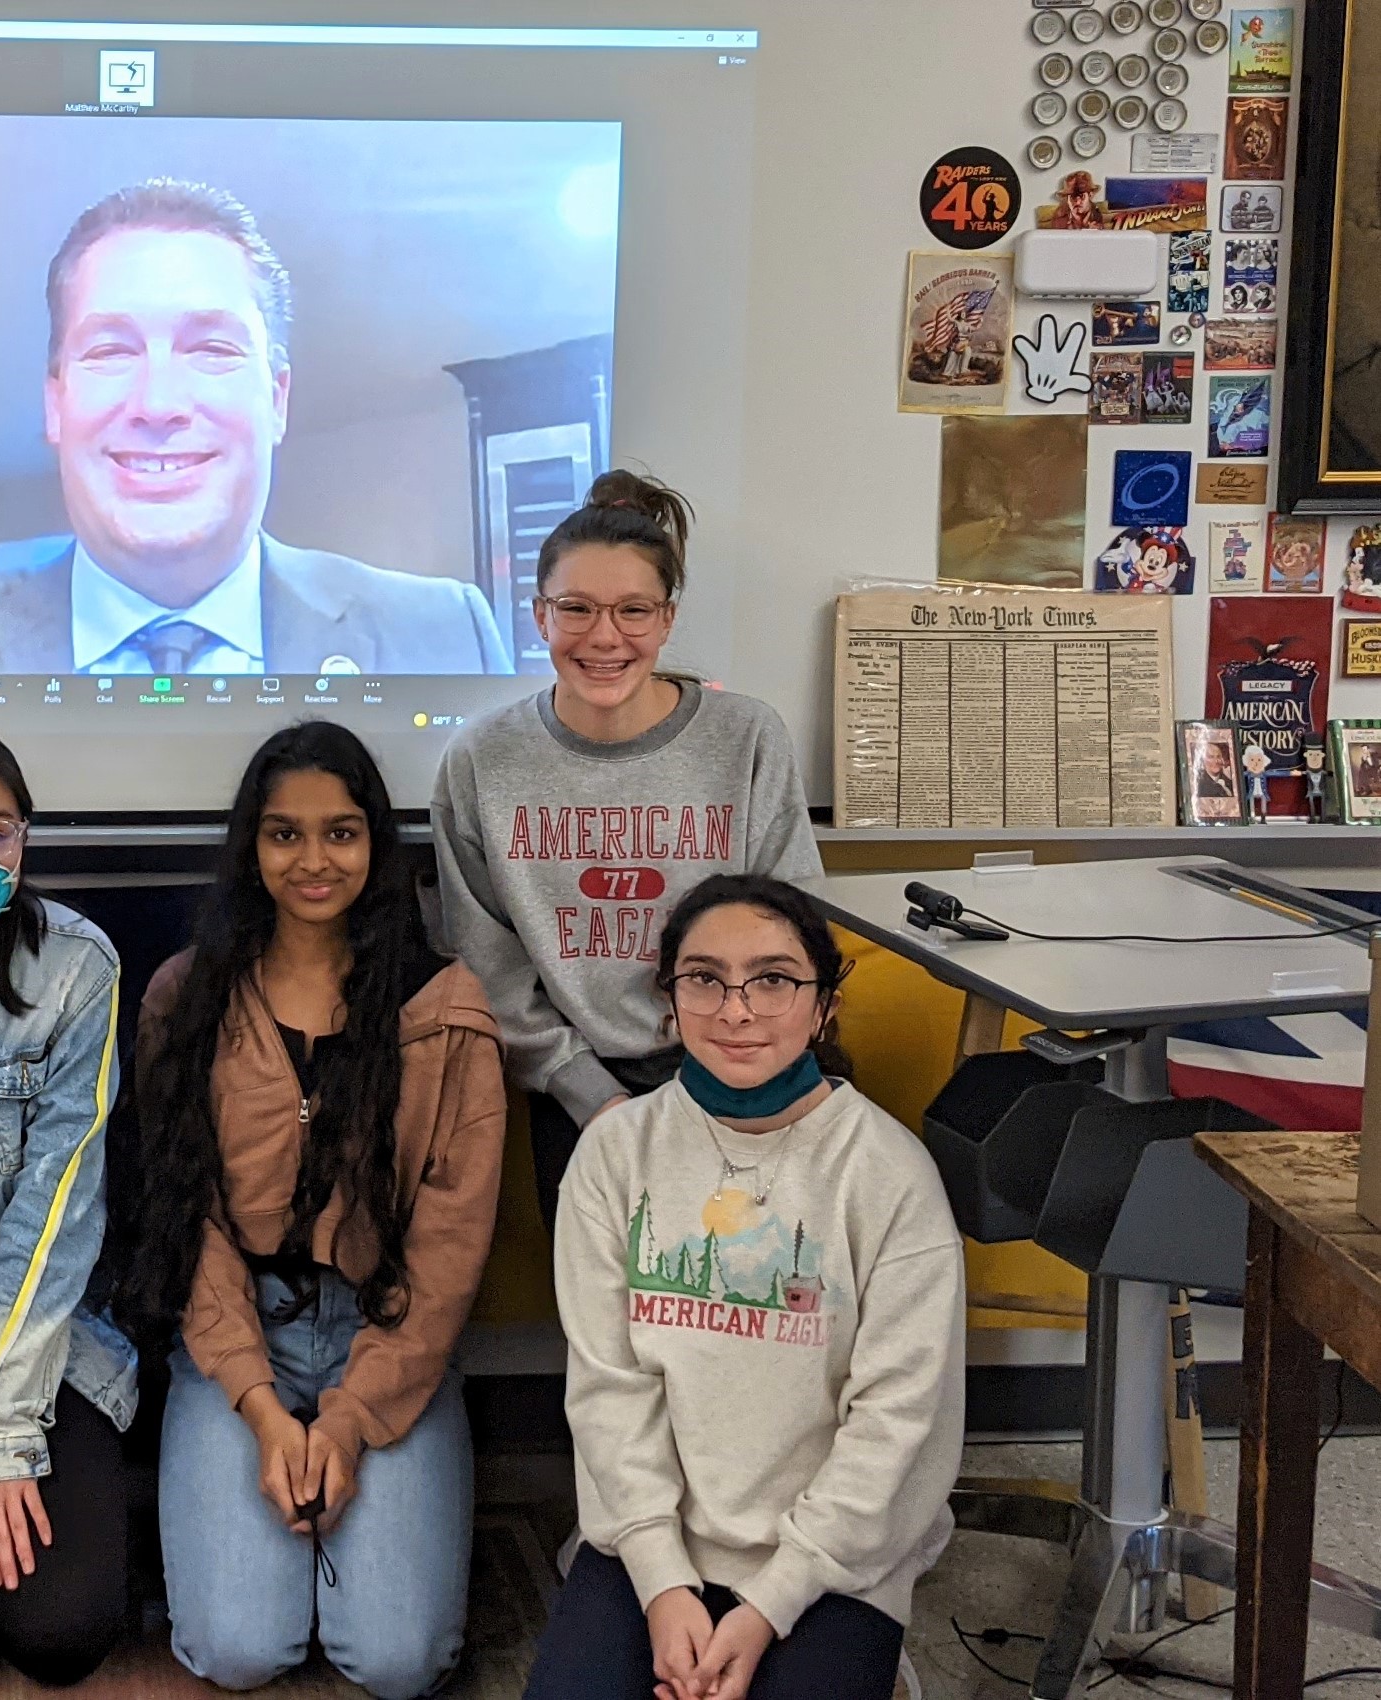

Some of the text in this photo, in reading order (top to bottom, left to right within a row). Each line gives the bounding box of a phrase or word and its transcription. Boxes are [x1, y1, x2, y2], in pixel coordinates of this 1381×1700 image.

[933, 165, 992, 190] RAIDERS
[970, 221, 1008, 232] YEARS
[911, 605, 938, 627] The
[1043, 605, 1097, 628] Times.
[1248, 681, 1286, 690] LEGACY
[1224, 700, 1310, 728] AMERICAN
[1238, 729, 1296, 750] ISTORY
[508, 805, 732, 861] AMERICAN
[603, 871, 640, 898] 77
[555, 907, 660, 961] EAGL
[629, 1293, 826, 1347] MERICAN EAGL
